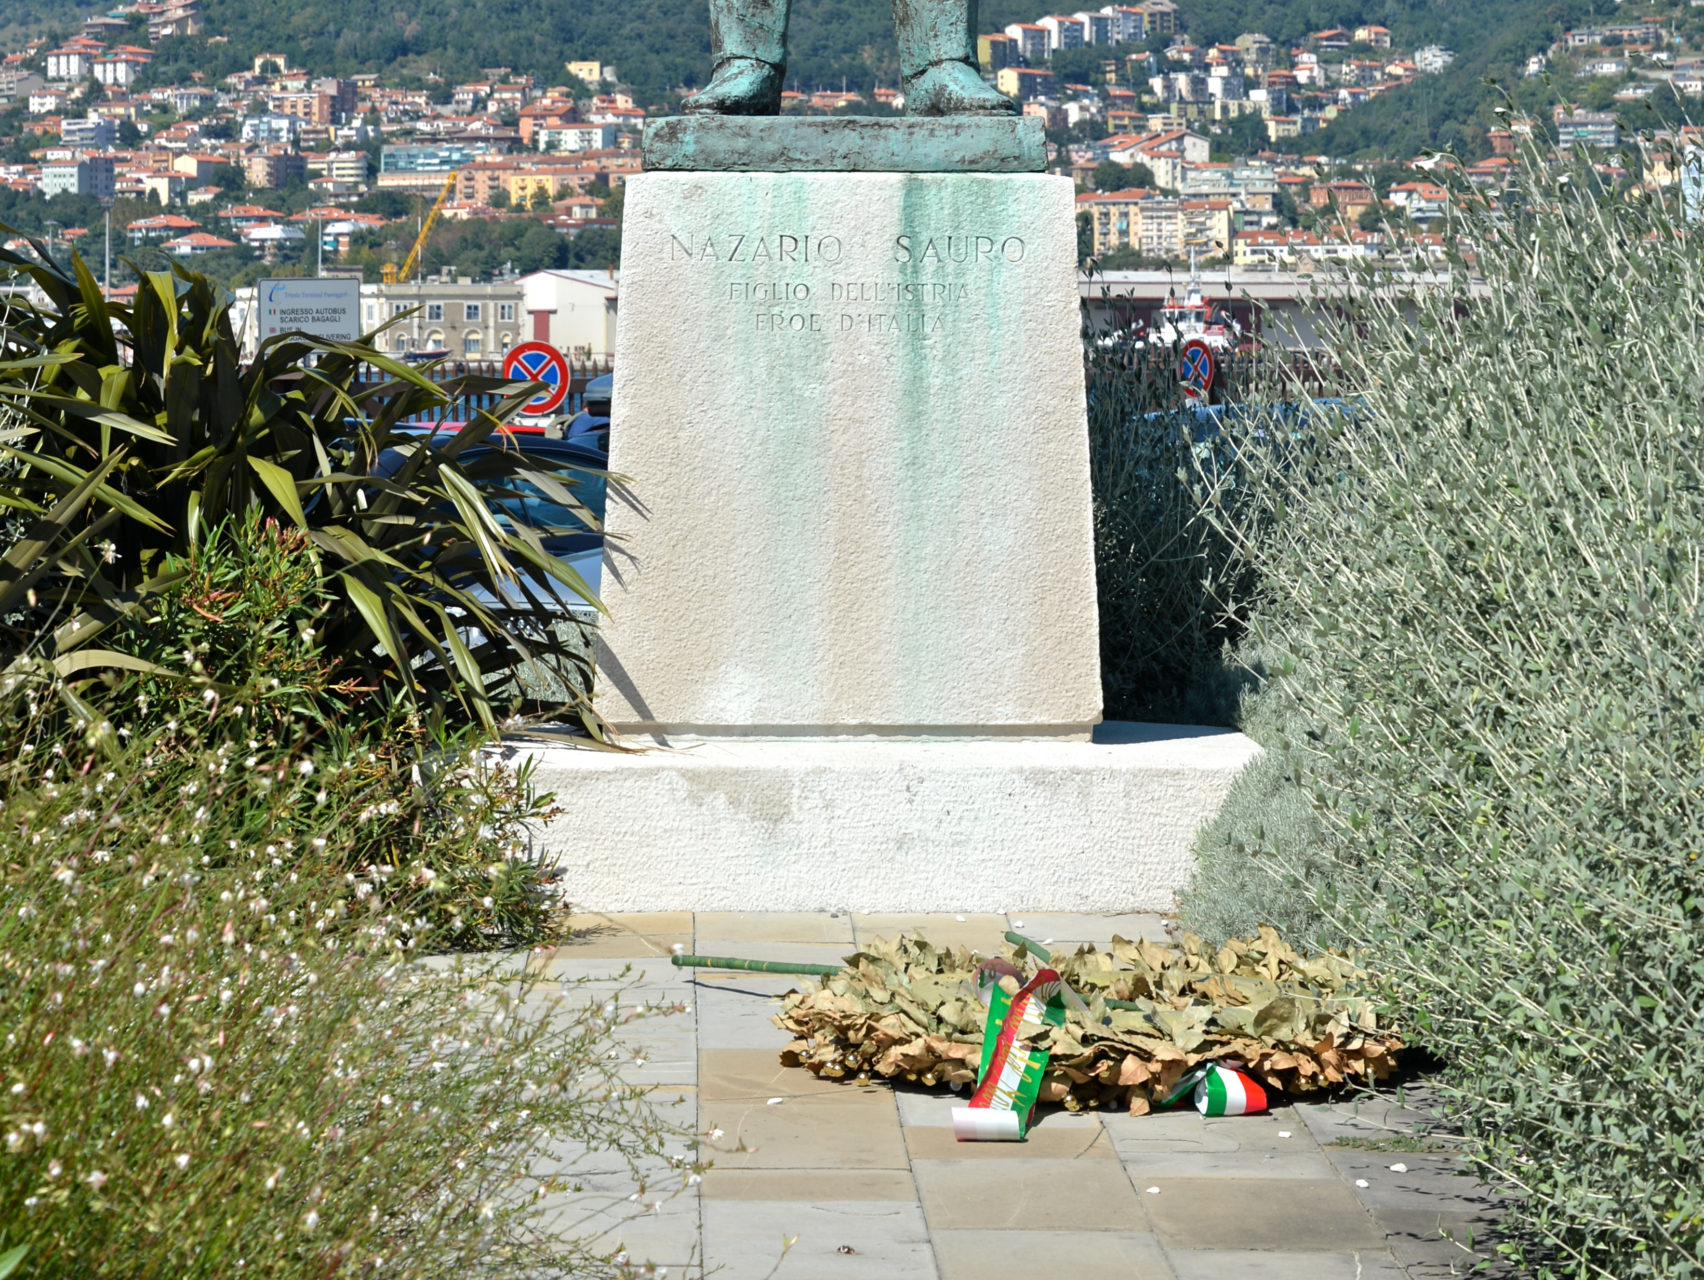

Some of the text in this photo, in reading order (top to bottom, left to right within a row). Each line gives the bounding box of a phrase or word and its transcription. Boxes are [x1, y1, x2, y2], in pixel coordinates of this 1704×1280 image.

[670, 234, 1026, 264] NAZARIO SAURO
[729, 282, 969, 302] FIGLIO DELL'ISTRIA
[279, 307, 346, 316] INGRESSO AUTOBUS
[279, 315, 341, 324] SCARICO BAGAGLI
[756, 313, 946, 332] EROE D'ITALIA
